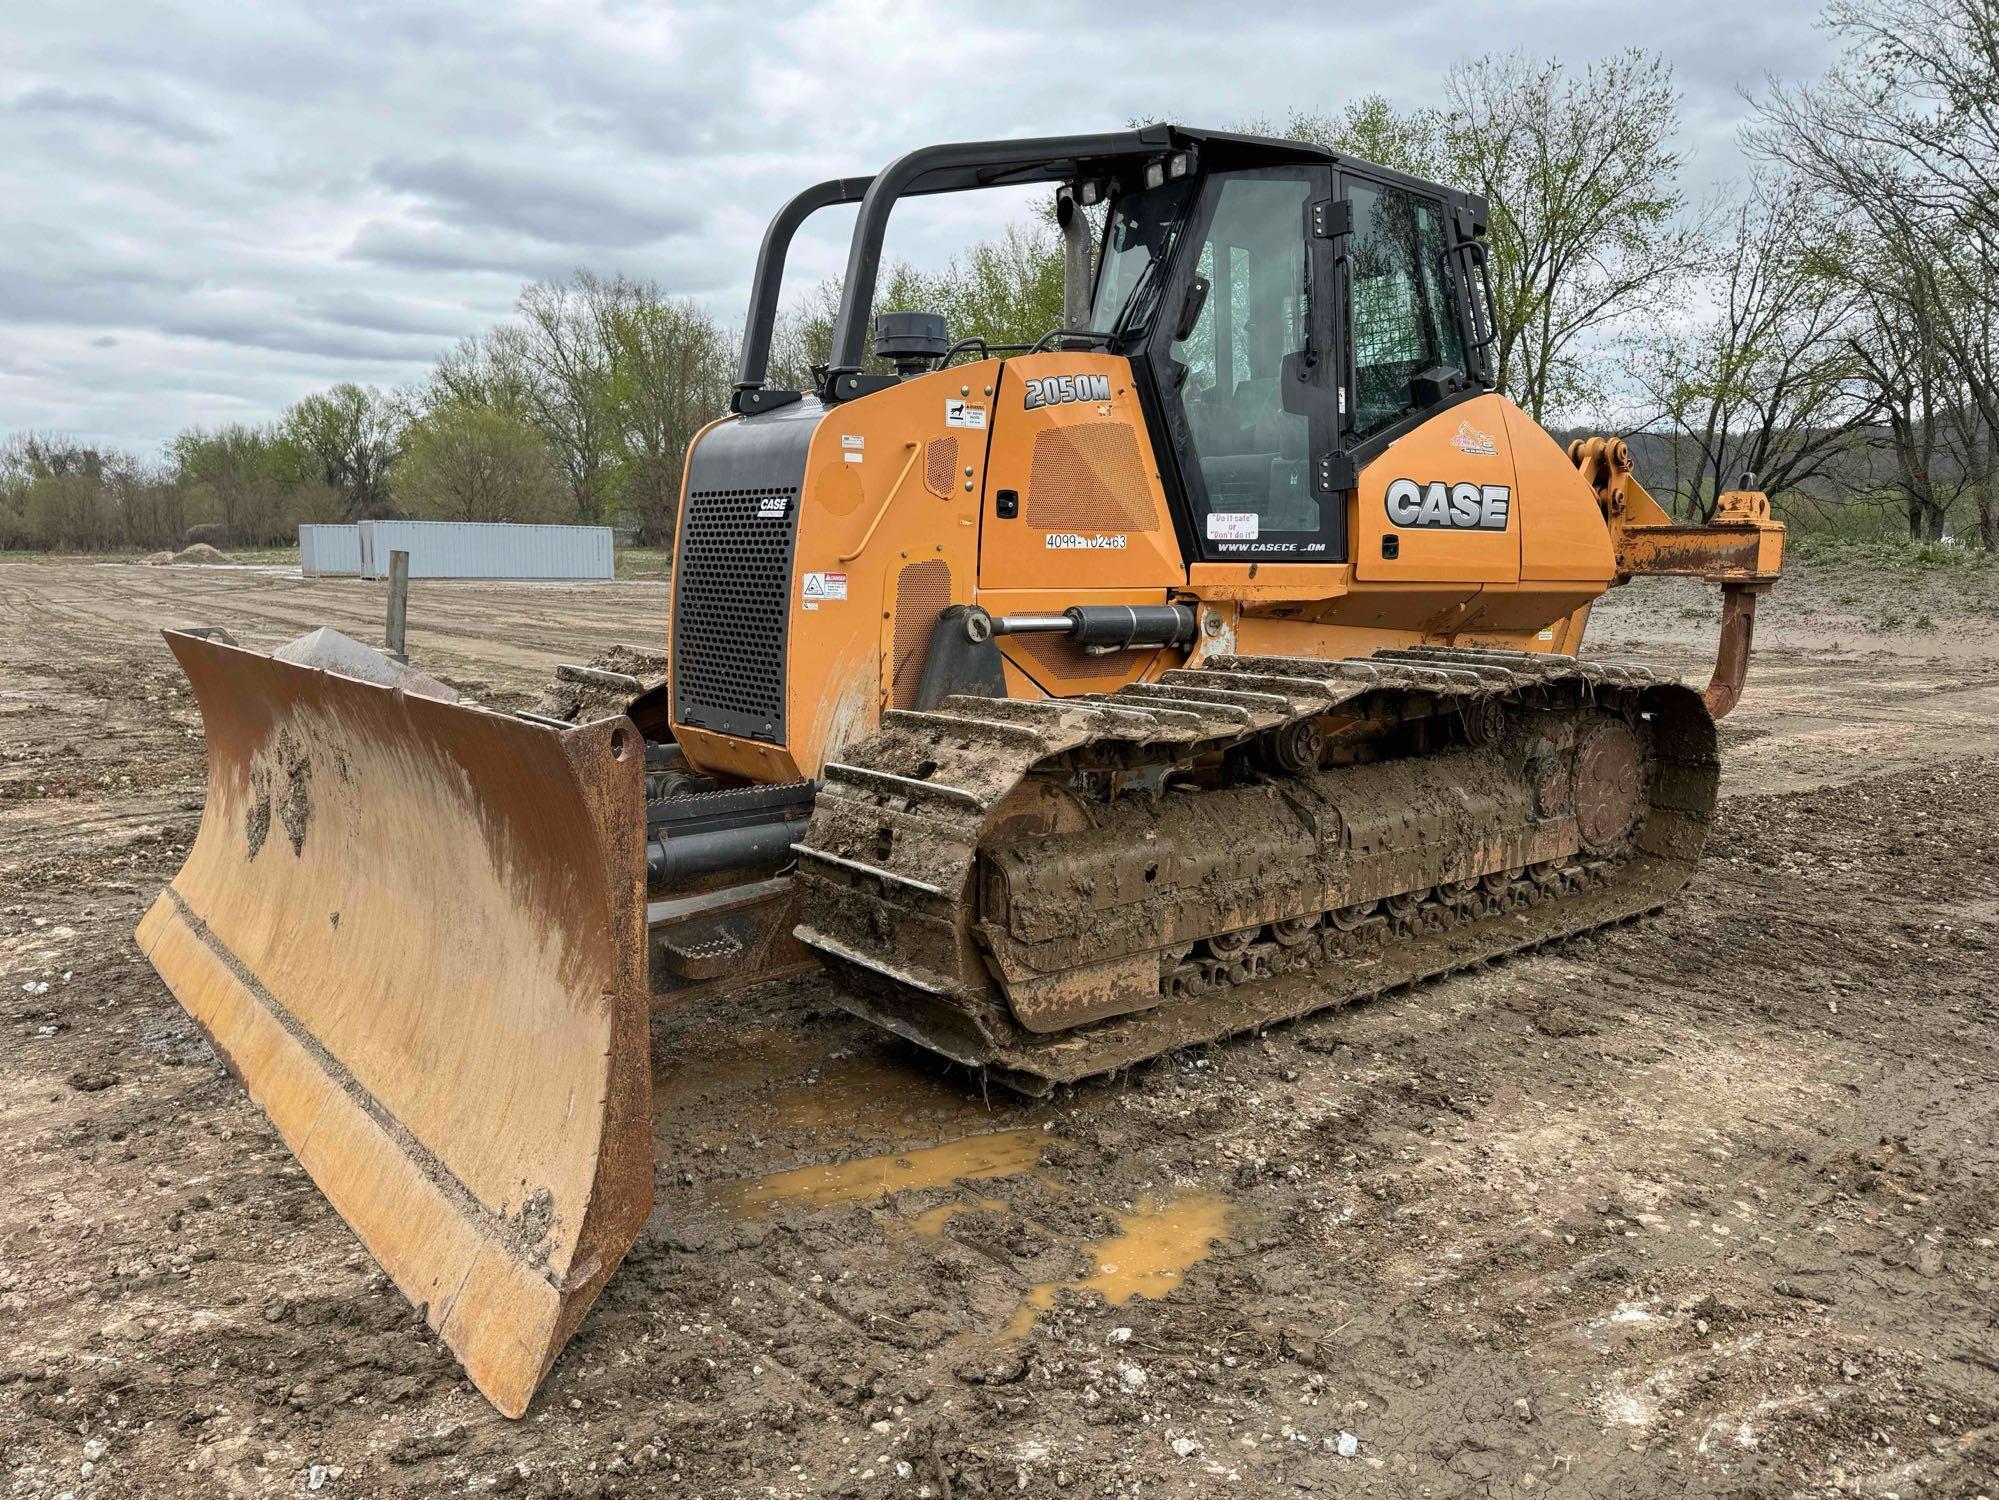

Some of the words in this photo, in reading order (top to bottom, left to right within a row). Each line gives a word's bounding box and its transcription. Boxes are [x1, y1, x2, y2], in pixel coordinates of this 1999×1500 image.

[1023, 374, 1111, 411] 2050M
[761, 498, 788, 510] CASE
[1386, 479, 1509, 528] CASE
[1234, 531, 1244, 539] do
